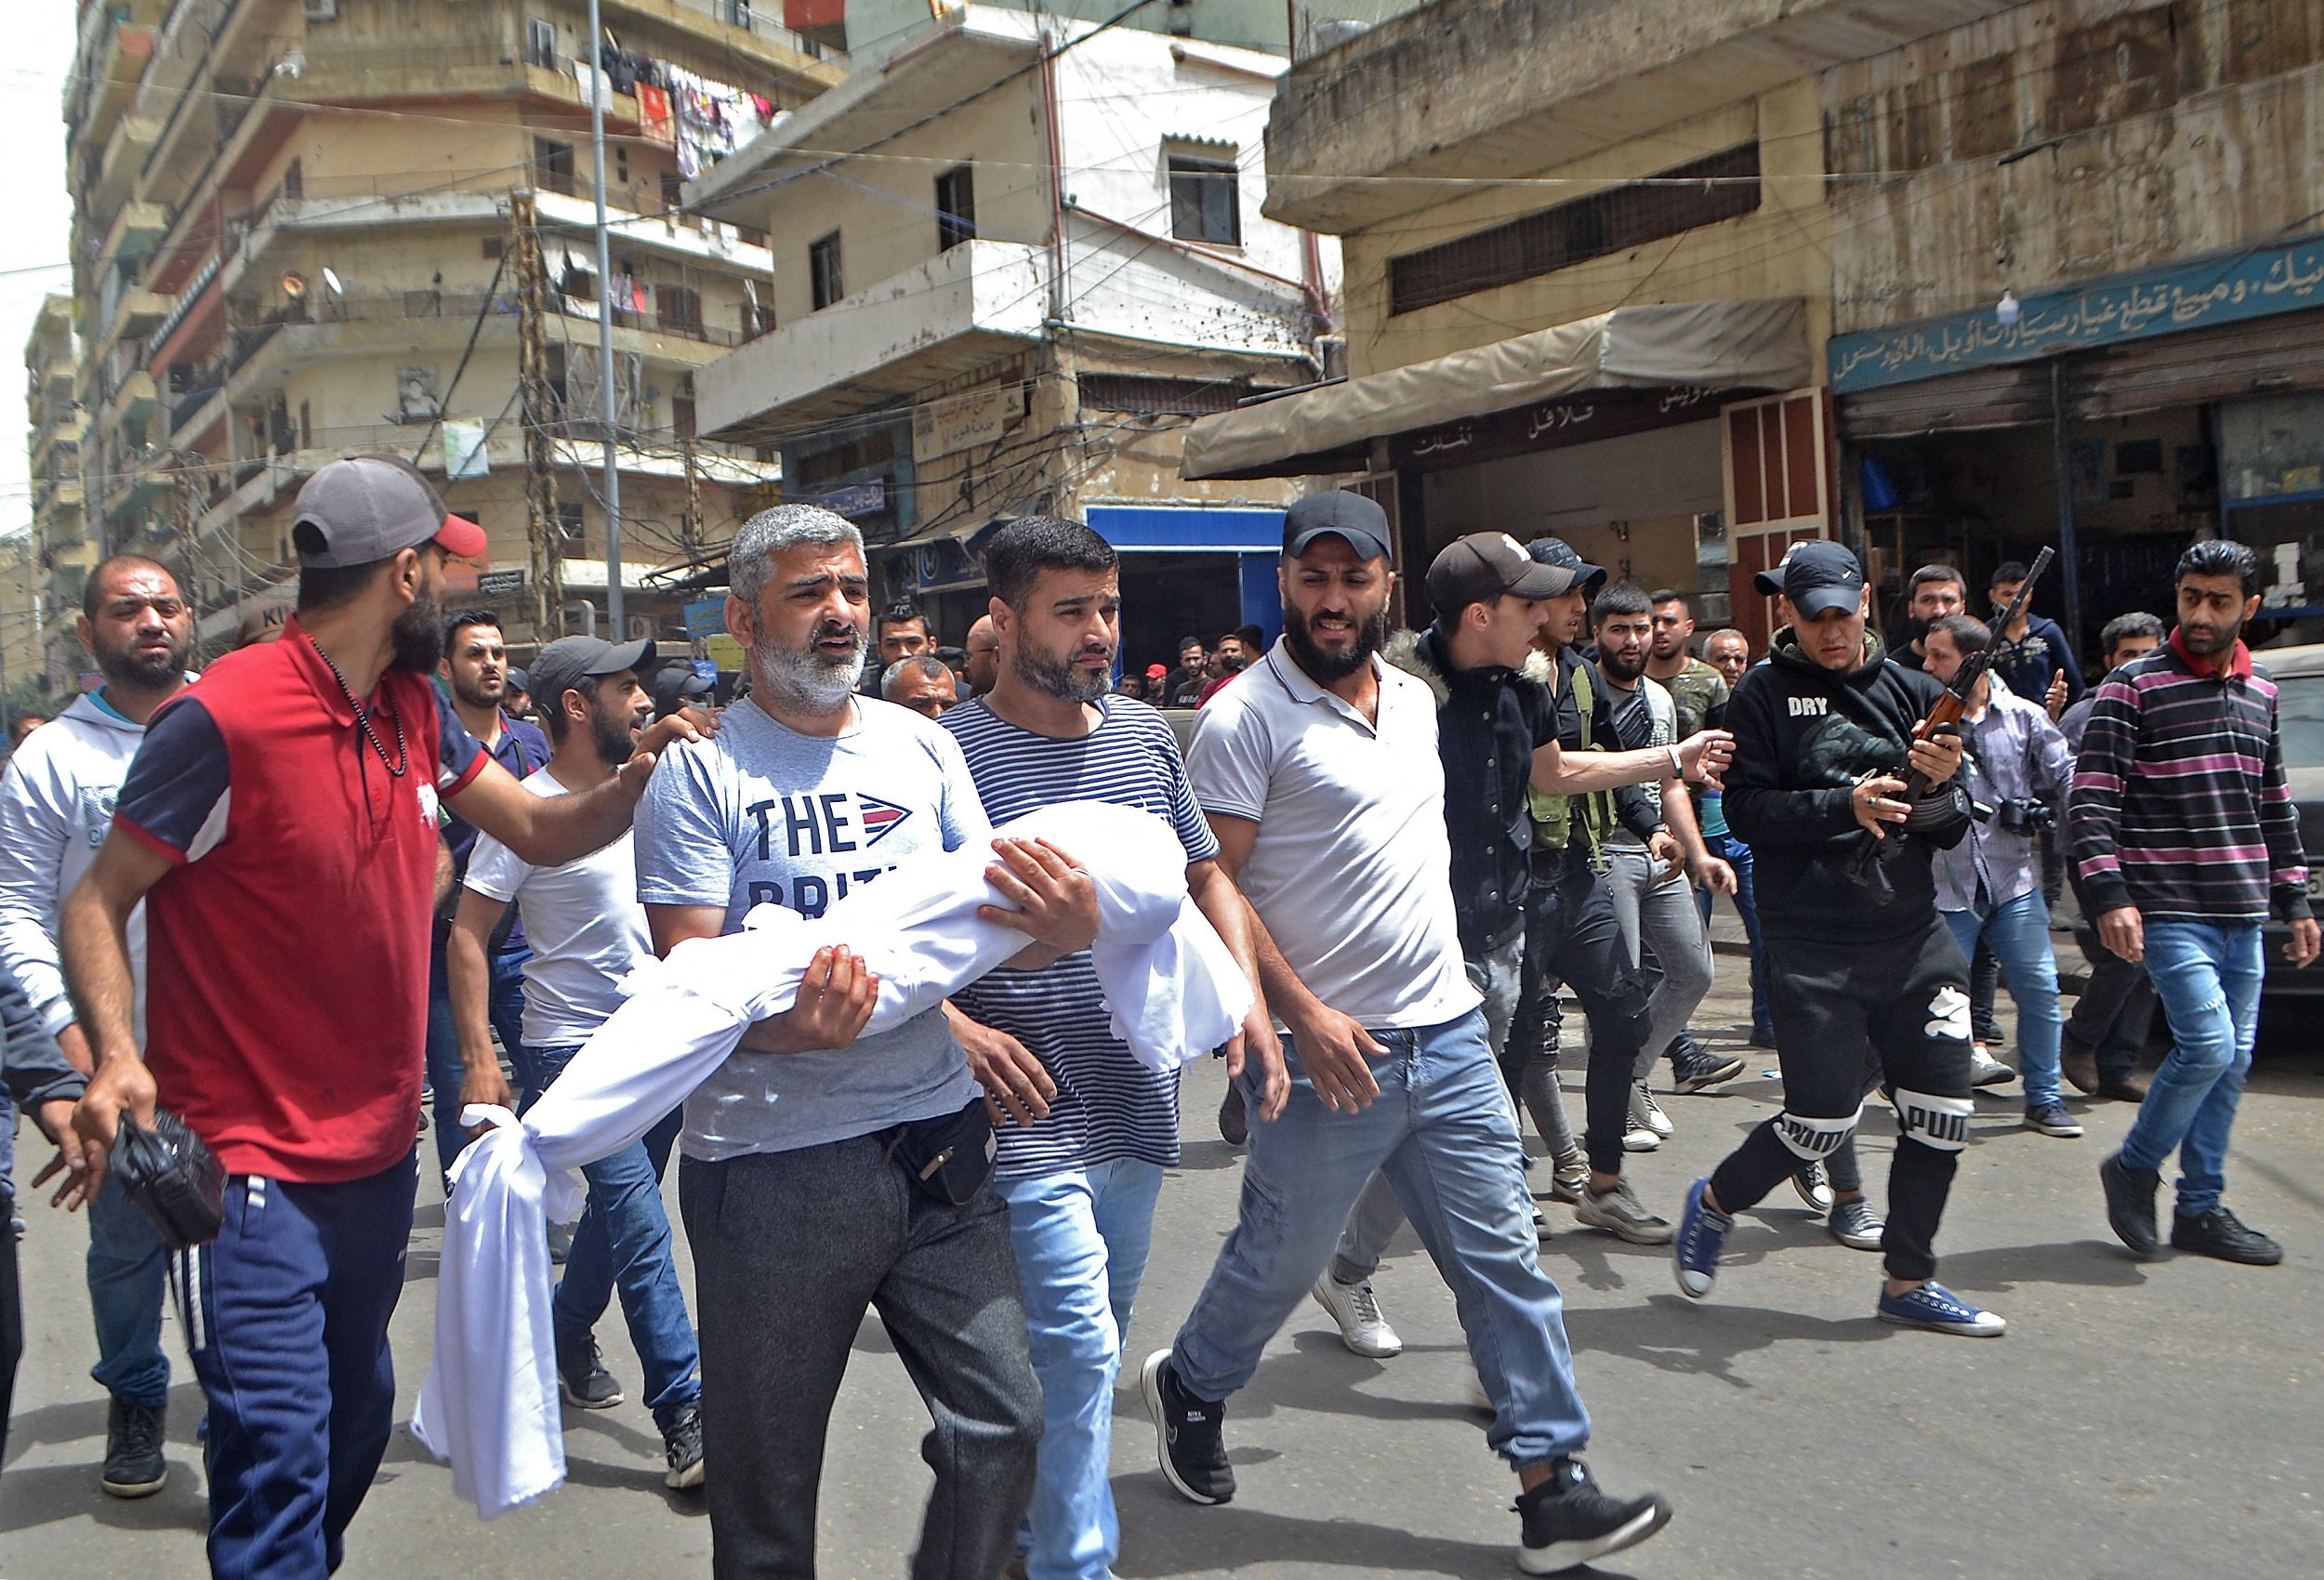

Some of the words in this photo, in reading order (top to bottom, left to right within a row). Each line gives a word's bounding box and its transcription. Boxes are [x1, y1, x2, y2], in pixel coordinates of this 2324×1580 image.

[262, 605, 290, 628] KI
[1788, 696, 1828, 717] DRY
[746, 793, 857, 861] THE
